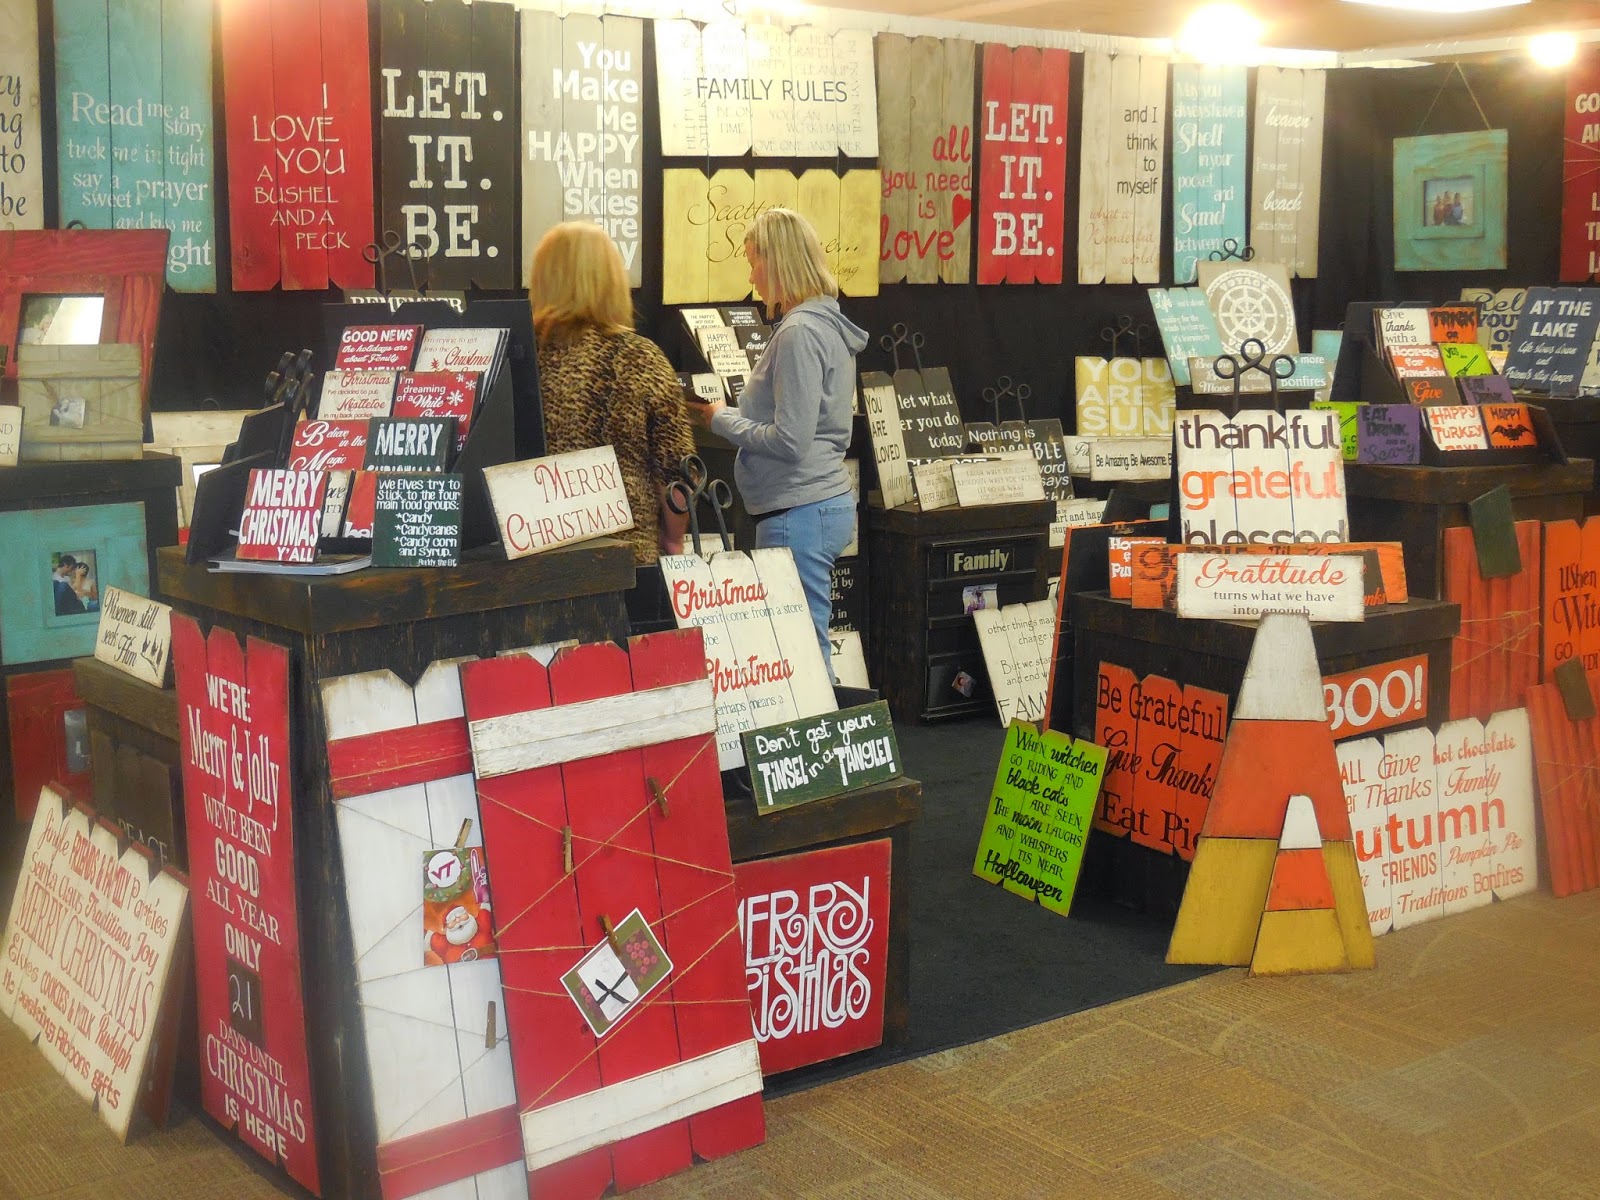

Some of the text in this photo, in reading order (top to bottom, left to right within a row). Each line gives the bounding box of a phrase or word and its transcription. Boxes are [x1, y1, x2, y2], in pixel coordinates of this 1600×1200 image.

[577, 41, 631, 69] You
[382, 68, 503, 121] LET.
[552, 68, 639, 103] Make
[696, 77, 848, 102] FAMILY RULES
[71, 91, 190, 128] Read me a
[596, 104, 637, 132] Me
[985, 101, 1063, 145] LET.
[1265, 106, 1310, 128] heaven
[165, 119, 205, 138] story
[252, 115, 340, 142] LOVE
[1126, 134, 1157, 150] think
[1179, 122, 1223, 153] Shell
[528, 131, 639, 163] HAPPY
[932, 124, 972, 163] all
[257, 166, 273, 182] A
[277, 148, 346, 175] YOU
[409, 135, 492, 190] IT.
[557, 161, 638, 189] When
[1143, 154, 1157, 171] to
[880, 169, 972, 198] you need
[1000, 155, 1053, 201] IT.
[1117, 177, 1157, 199] myself
[1178, 173, 1214, 191] pocket
[82, 180, 208, 209] sweet prayer
[255, 186, 338, 204] BUSHEL
[564, 188, 638, 215] Skies
[918, 194, 937, 219] is
[1263, 190, 1301, 211] beach
[270, 209, 334, 226] AND A
[1181, 203, 1225, 234] Sand
[296, 232, 350, 250] PECK
[401, 205, 499, 258] BE.
[880, 214, 955, 261] love
[992, 212, 1055, 257] BE.
[1219, 277, 1270, 291] VOYAGE
[1382, 309, 1405, 320] Give
[1529, 300, 1593, 316] AT THE
[342, 329, 414, 343] GOOD NEWS
[1386, 321, 1415, 332] thanks
[1530, 322, 1579, 338] LAKE
[1081, 358, 1171, 383] YOU
[1301, 356, 1324, 364] more
[399, 376, 414, 385] I'm
[404, 384, 446, 396] dreaming
[1281, 374, 1326, 388] Bonfires
[337, 397, 386, 411] Mistletoe
[865, 395, 883, 414] YOU
[897, 391, 953, 409] let what
[1078, 385, 1154, 406] ARE
[917, 411, 959, 432] you do
[1431, 407, 1476, 424] HAPPY
[1491, 407, 1520, 420] HAPPY
[375, 422, 443, 456] MERRY
[872, 420, 888, 438] ARE
[928, 433, 963, 448] today
[968, 427, 1035, 442] Nothing is
[1180, 414, 1341, 450] thankful
[1433, 425, 1482, 444] TURKEY
[875, 444, 900, 464] LOVED
[250, 470, 323, 507] MERRY
[377, 490, 460, 500] Stick to the four
[379, 479, 460, 491] We Elves try to
[534, 461, 617, 504] MERRY
[1181, 460, 1342, 511] grateful
[376, 499, 459, 512] main food groups:
[239, 508, 321, 547] CHRISTMAS
[507, 500, 628, 551] CHRISTMAS
[277, 547, 315, 562] Y'ALL
[399, 547, 452, 557] and syrup.
[665, 557, 697, 574] Maybe
[953, 549, 1009, 572] Family
[1195, 557, 1348, 588] Gratitude
[673, 578, 768, 619] Christmas
[1213, 590, 1335, 602] turns what we have
[104, 590, 159, 630] Wisemen still
[101, 624, 137, 667] seek Him
[1018, 631, 1048, 646] change
[1000, 660, 1034, 675] But we
[1007, 671, 1041, 685] and end
[205, 672, 251, 723] WE'RE
[1098, 673, 1121, 713] Be
[1128, 682, 1224, 743] Grateful
[756, 713, 877, 756] Don't get your
[1016, 726, 1099, 776] WHEN witches
[187, 704, 280, 832] Merry & Jolly
[1010, 754, 1083, 790] GO RIDING AND
[1007, 768, 1069, 806] black cats
[1365, 778, 1432, 809] Thanks
[1444, 763, 1502, 797] Family
[203, 792, 271, 858] WE'VE BEEN
[995, 824, 1068, 863] AND WHISPERS
[214, 836, 259, 898] GOOD
[431, 859, 455, 881] VT
[1018, 850, 1065, 881] TIS NEAR
[1382, 831, 1523, 888] FRIENDS Pumpkin Pie
[984, 849, 1062, 902] Halloween
[1398, 863, 1524, 915] Traditions Bonfires
[206, 876, 281, 945] ALL YEAR
[15, 875, 69, 960] MERRY
[60, 914, 154, 1042] CHRISTMAS
[224, 922, 262, 972] ONLY
[229, 974, 252, 1020] 21
[219, 1018, 287, 1086] DAYS UNTIL
[206, 1033, 306, 1144] CHRISTMAS
[224, 1093, 288, 1160] IS HERE
